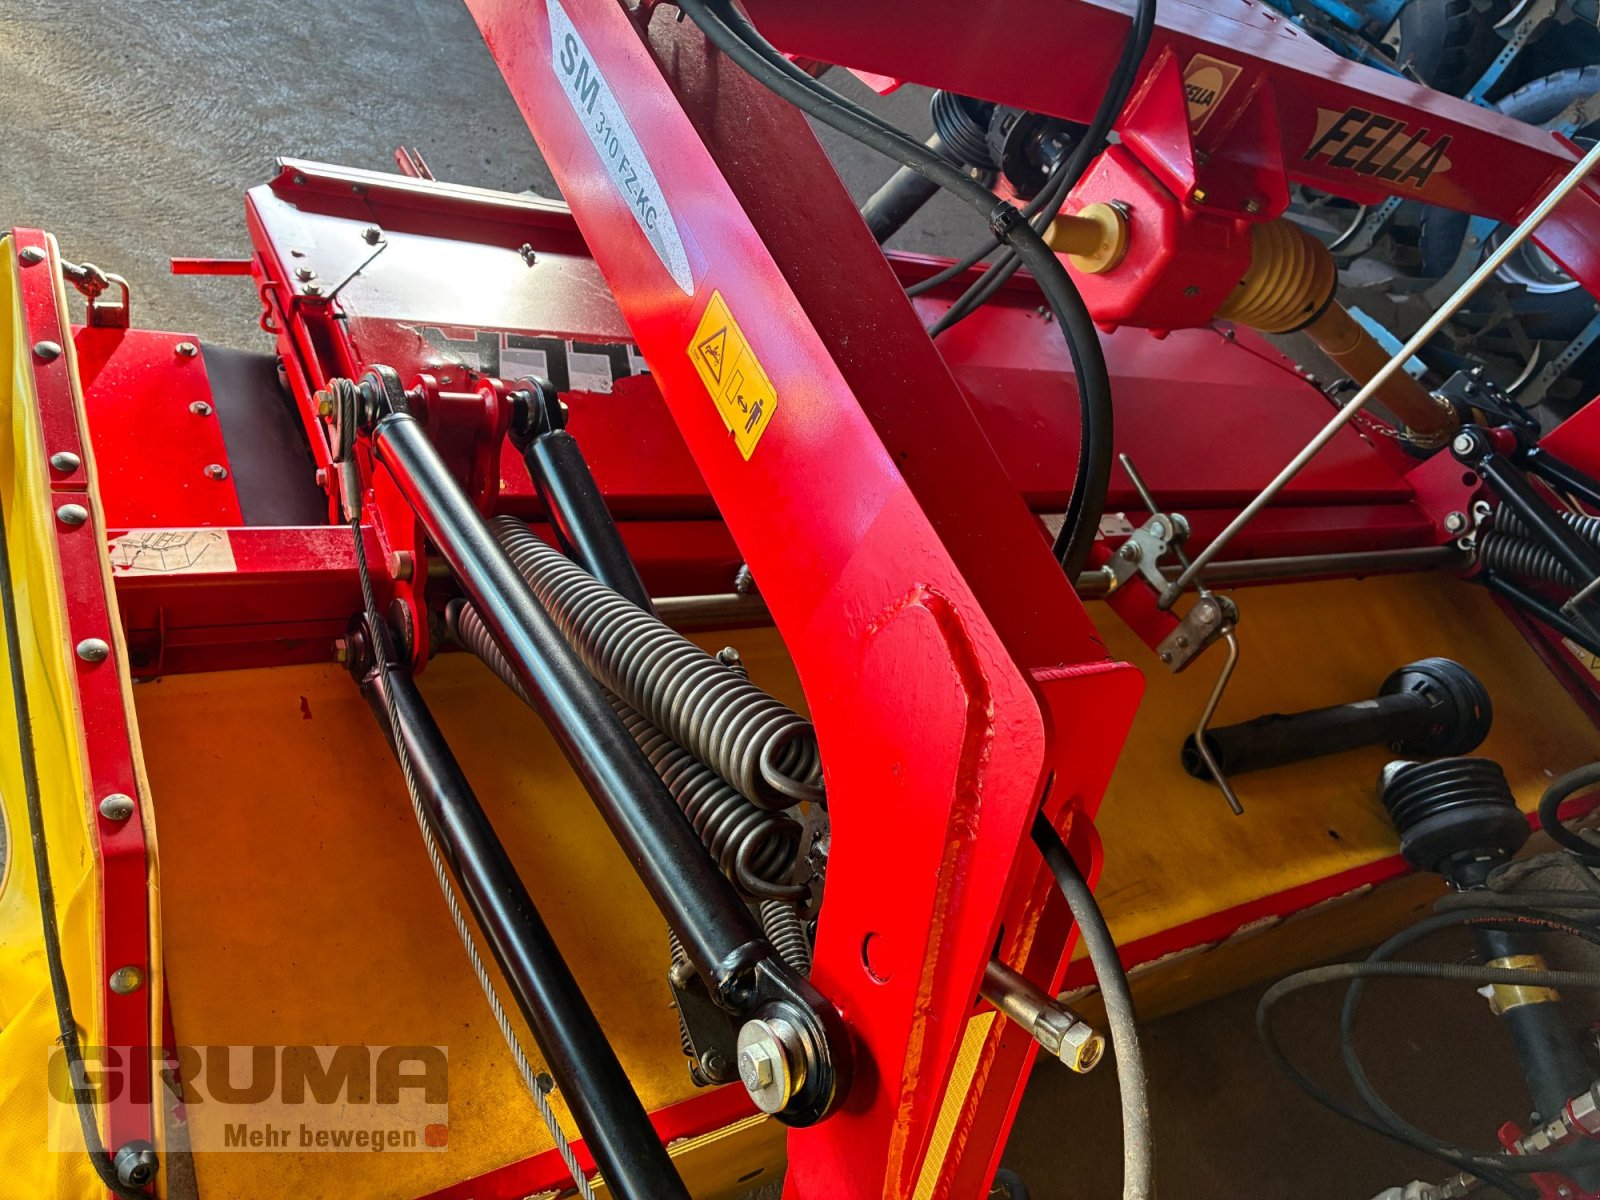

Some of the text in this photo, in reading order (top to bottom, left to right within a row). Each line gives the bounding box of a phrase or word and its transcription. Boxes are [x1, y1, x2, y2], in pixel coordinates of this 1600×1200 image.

[561, 33, 657, 230] SM 310 FZ-KC
[1303, 107, 1452, 189] FELLA
